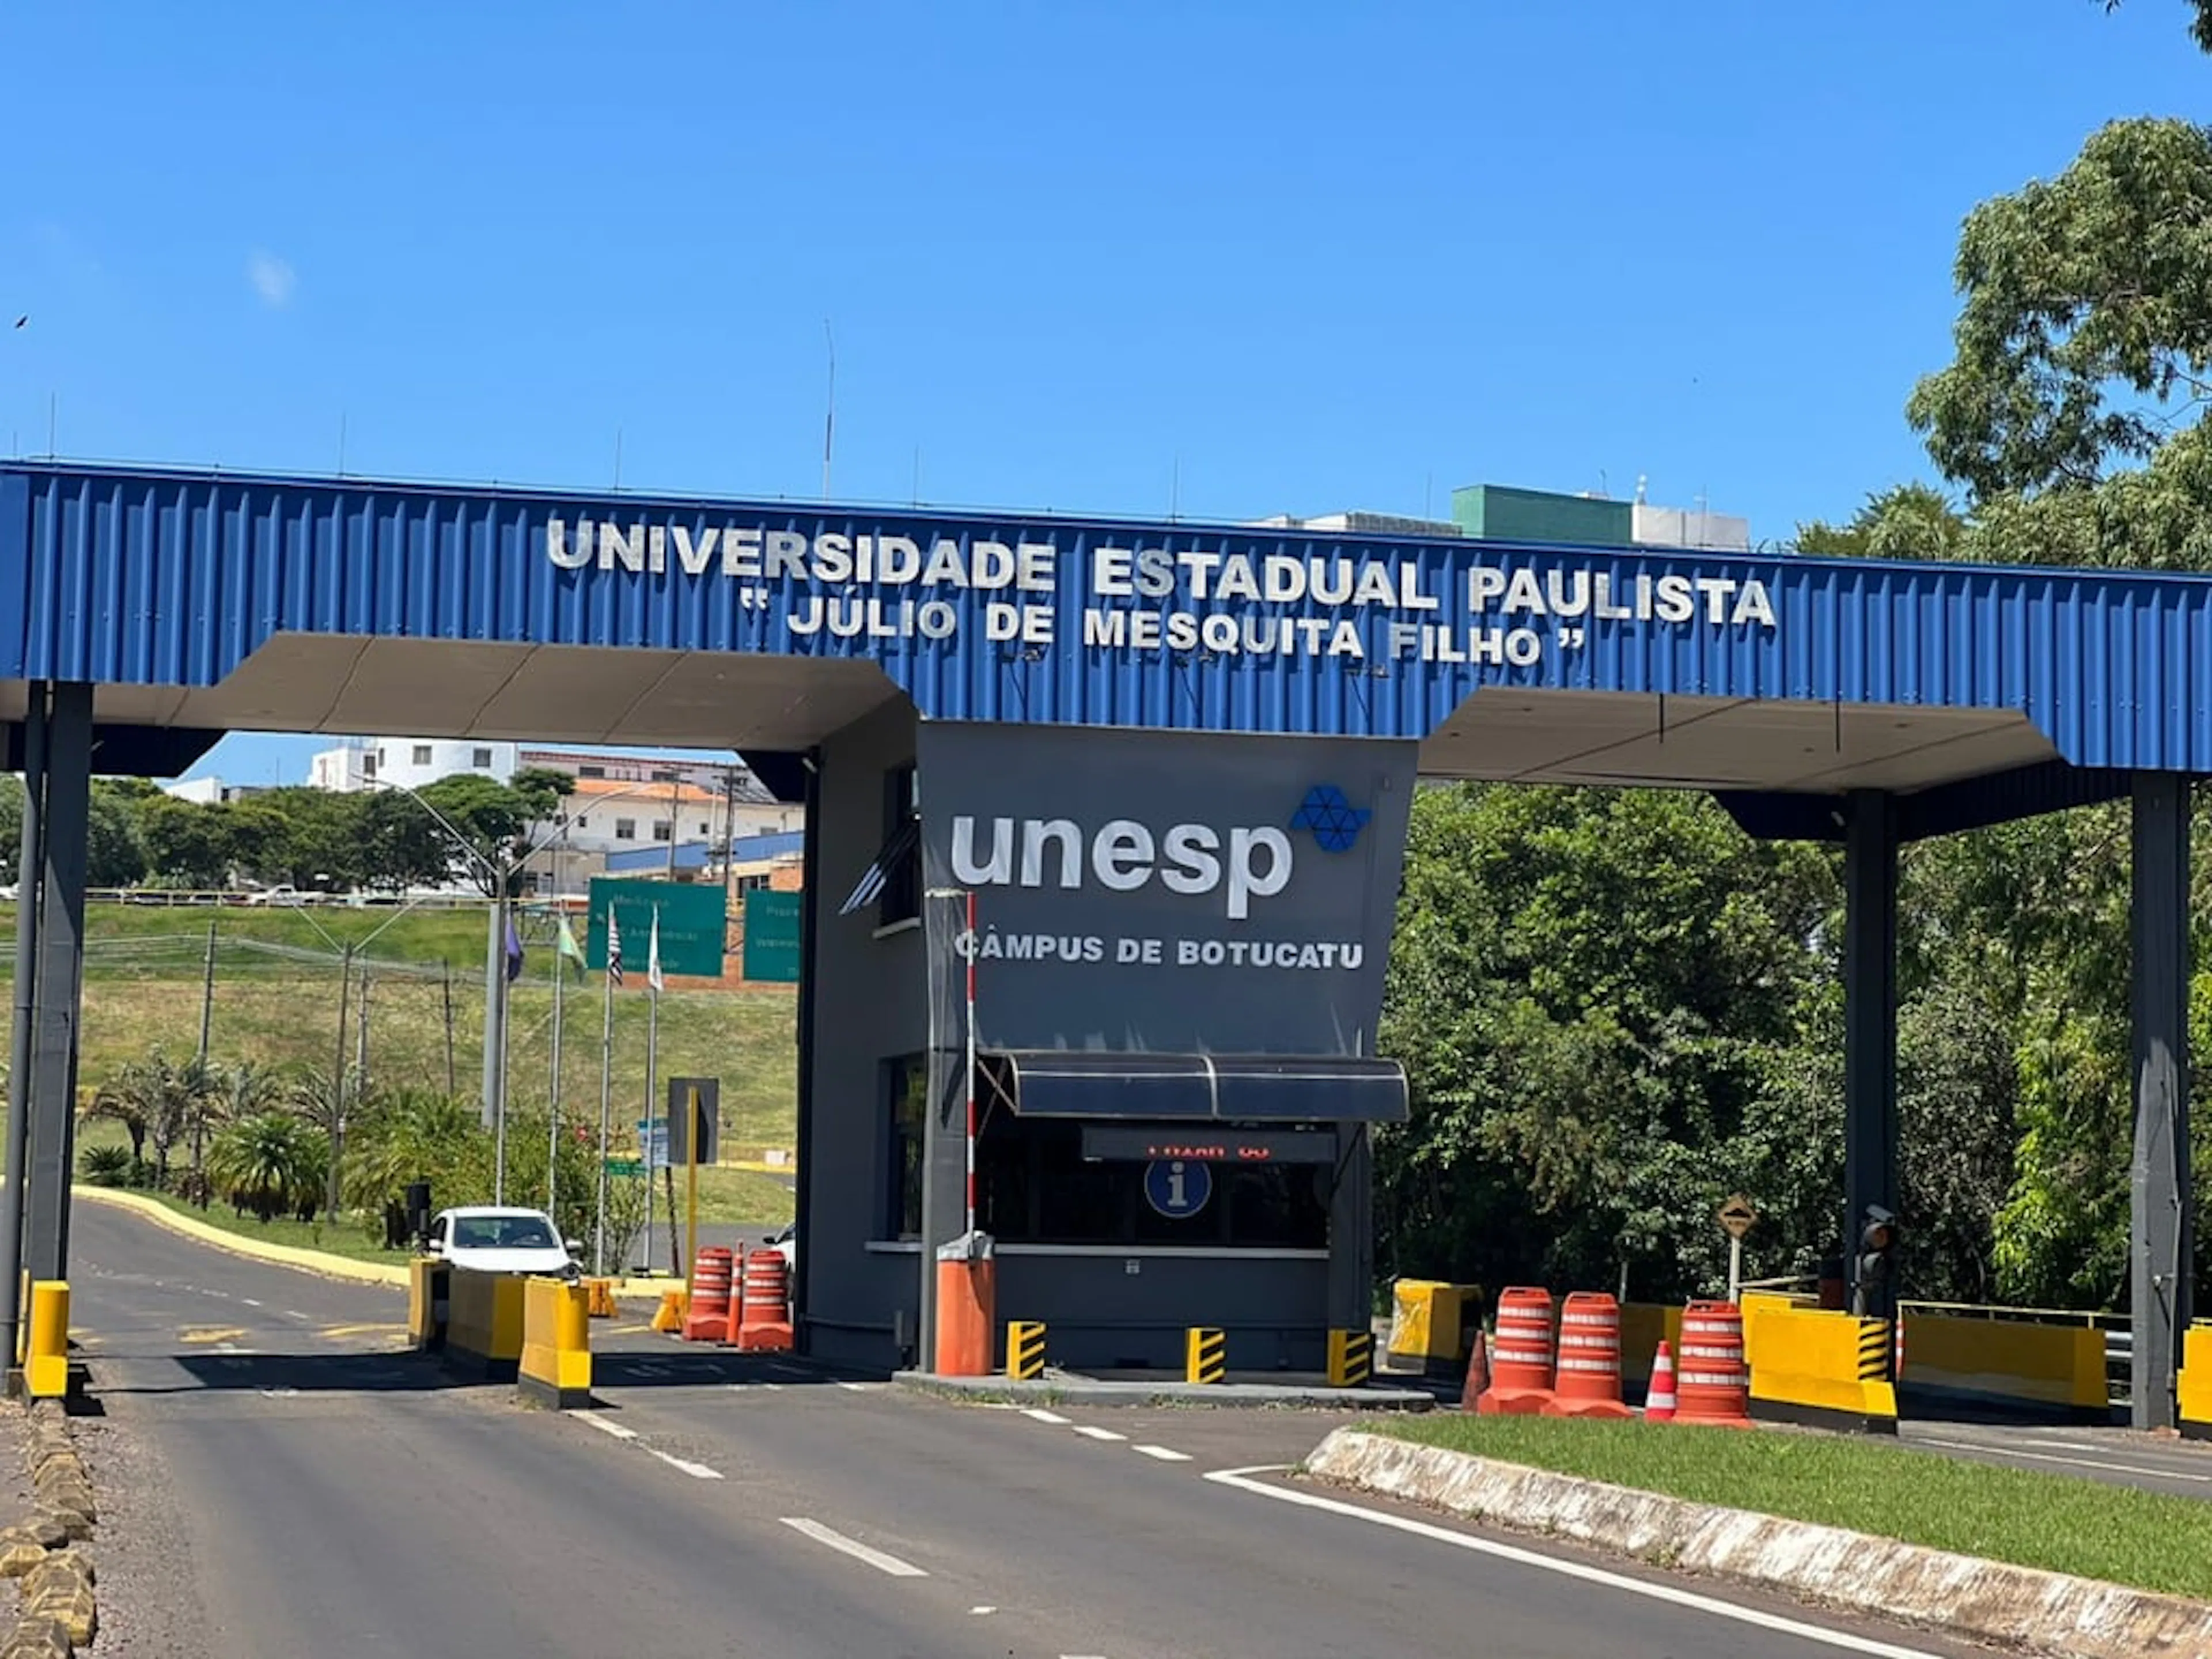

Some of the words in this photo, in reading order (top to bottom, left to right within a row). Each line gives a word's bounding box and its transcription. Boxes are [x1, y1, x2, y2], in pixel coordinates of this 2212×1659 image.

[547, 519, 1055, 591] UNIVERSIDADE
[1094, 548, 1438, 609] ESTADUAL
[1468, 566, 1775, 626] PAULISTA
[787, 584, 956, 638] JÚLIO
[986, 603, 1054, 643] DE
[1084, 609, 1364, 658] MESQUITA
[1389, 622, 1541, 666] FILHO
[951, 815, 1293, 920] unesp
[955, 924, 1103, 961] CÂMPUS
[1117, 939, 1162, 965] DE
[1177, 940, 1365, 969] BOTUCATU
